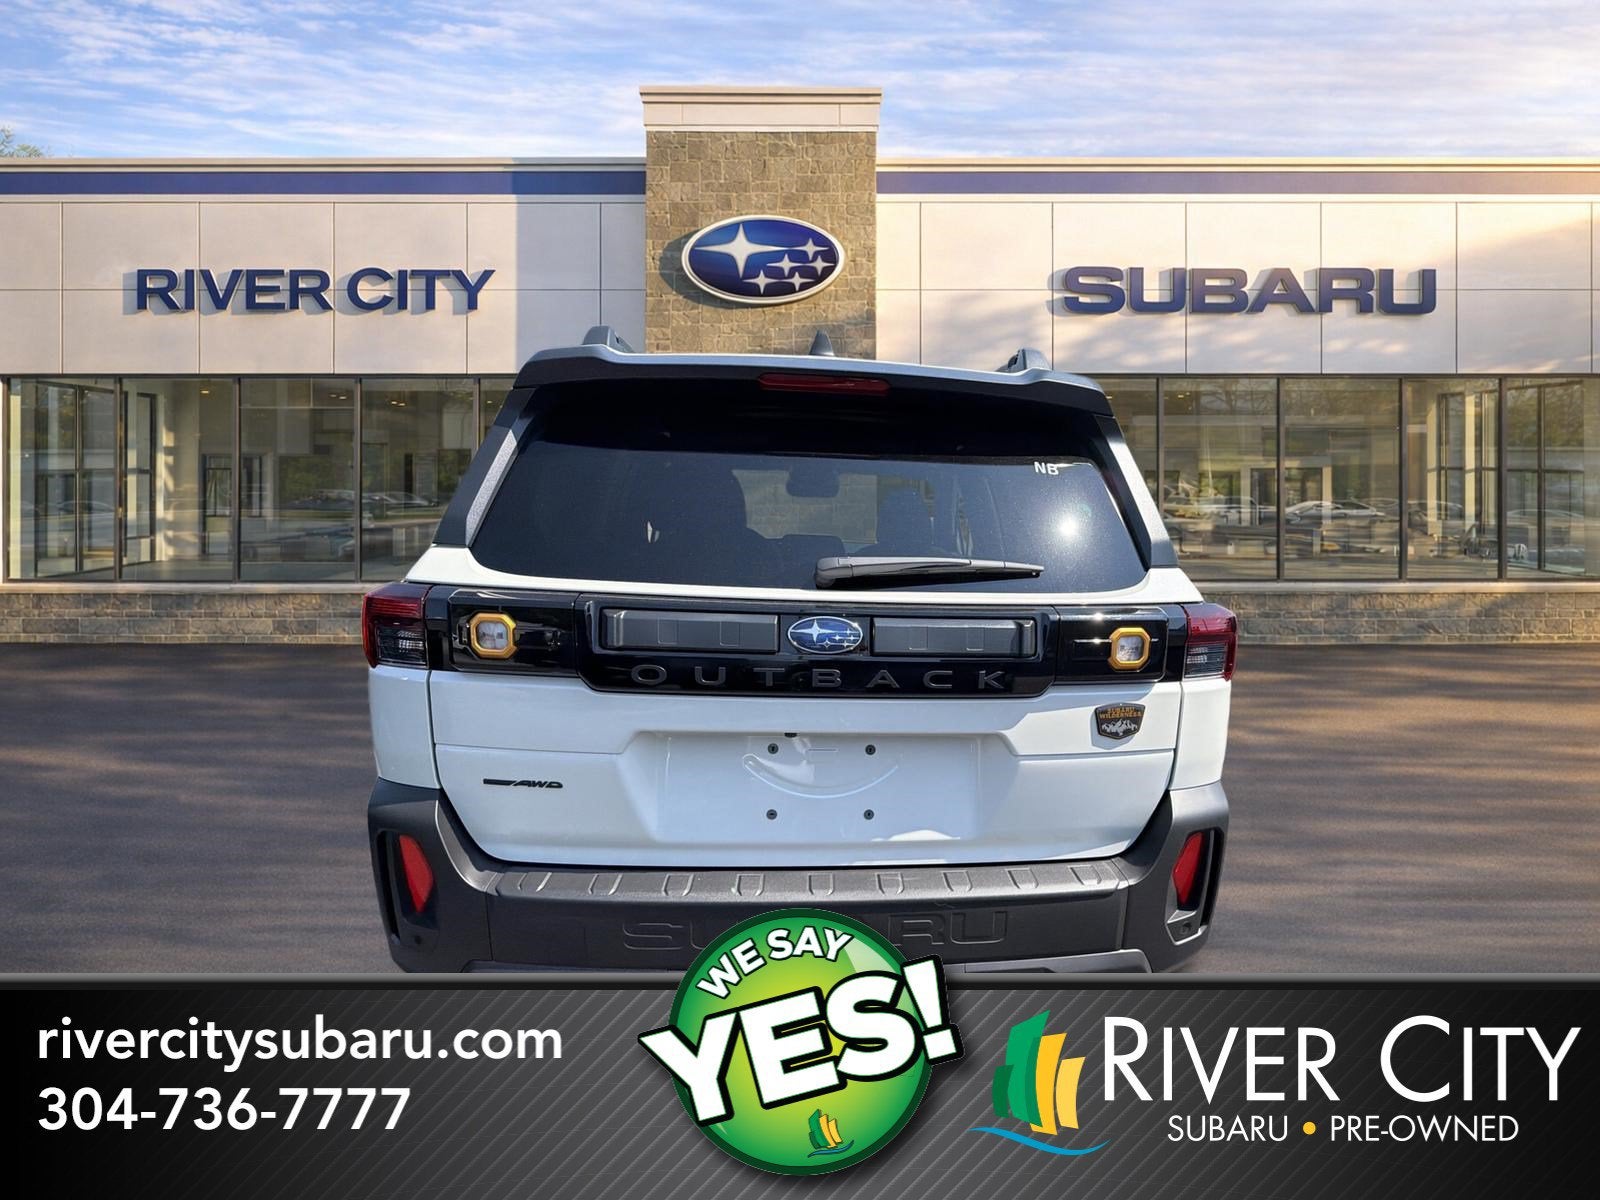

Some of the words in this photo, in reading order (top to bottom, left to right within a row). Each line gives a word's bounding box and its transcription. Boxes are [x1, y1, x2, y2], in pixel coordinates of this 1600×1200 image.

[136, 267, 335, 312] RIVER
[346, 266, 496, 311] CITY
[1063, 265, 1437, 315] SUBARU
[1033, 461, 1059, 475] NB
[630, 663, 1005, 690] OUTBACK
[1100, 710, 1142, 719] WILDERNESS
[512, 779, 563, 789] AWD
